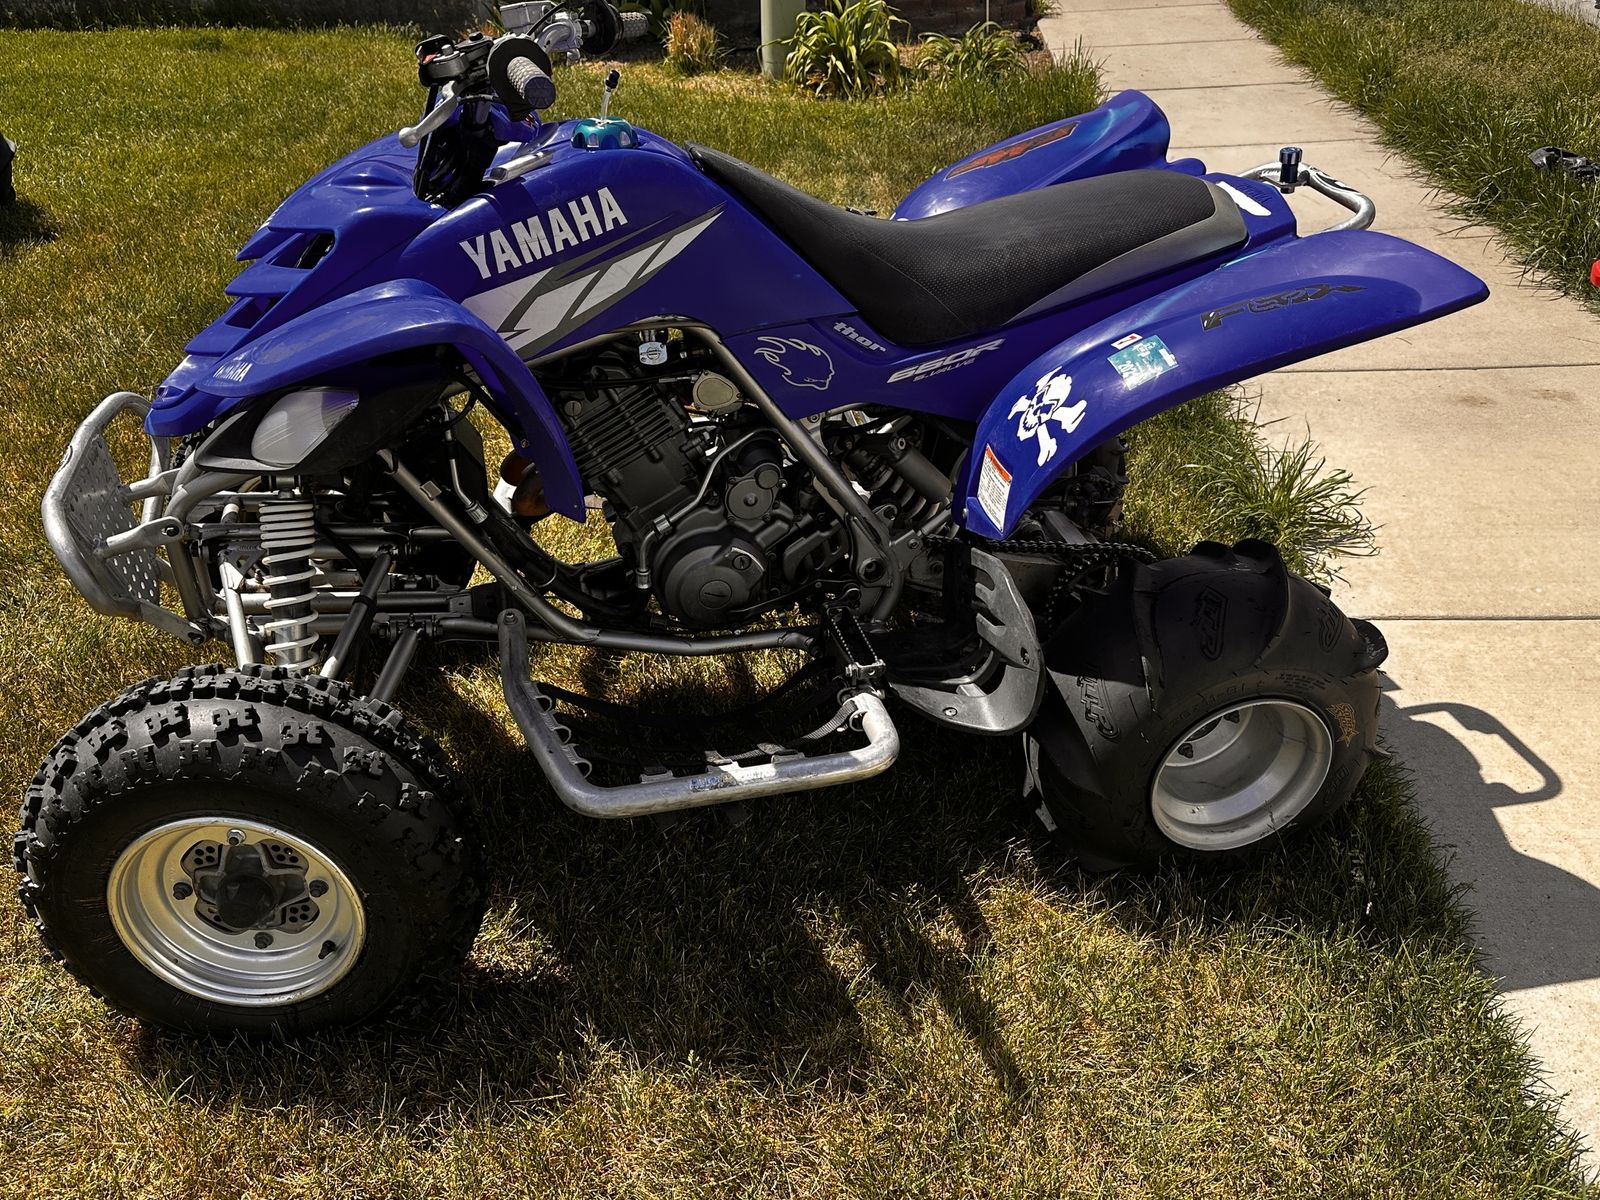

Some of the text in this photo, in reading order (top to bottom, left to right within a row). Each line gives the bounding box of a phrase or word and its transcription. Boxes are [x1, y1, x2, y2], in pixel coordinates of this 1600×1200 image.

[459, 186, 628, 280] YAMAHA
[833, 321, 886, 352] thor
[886, 338, 1006, 384] 660R
